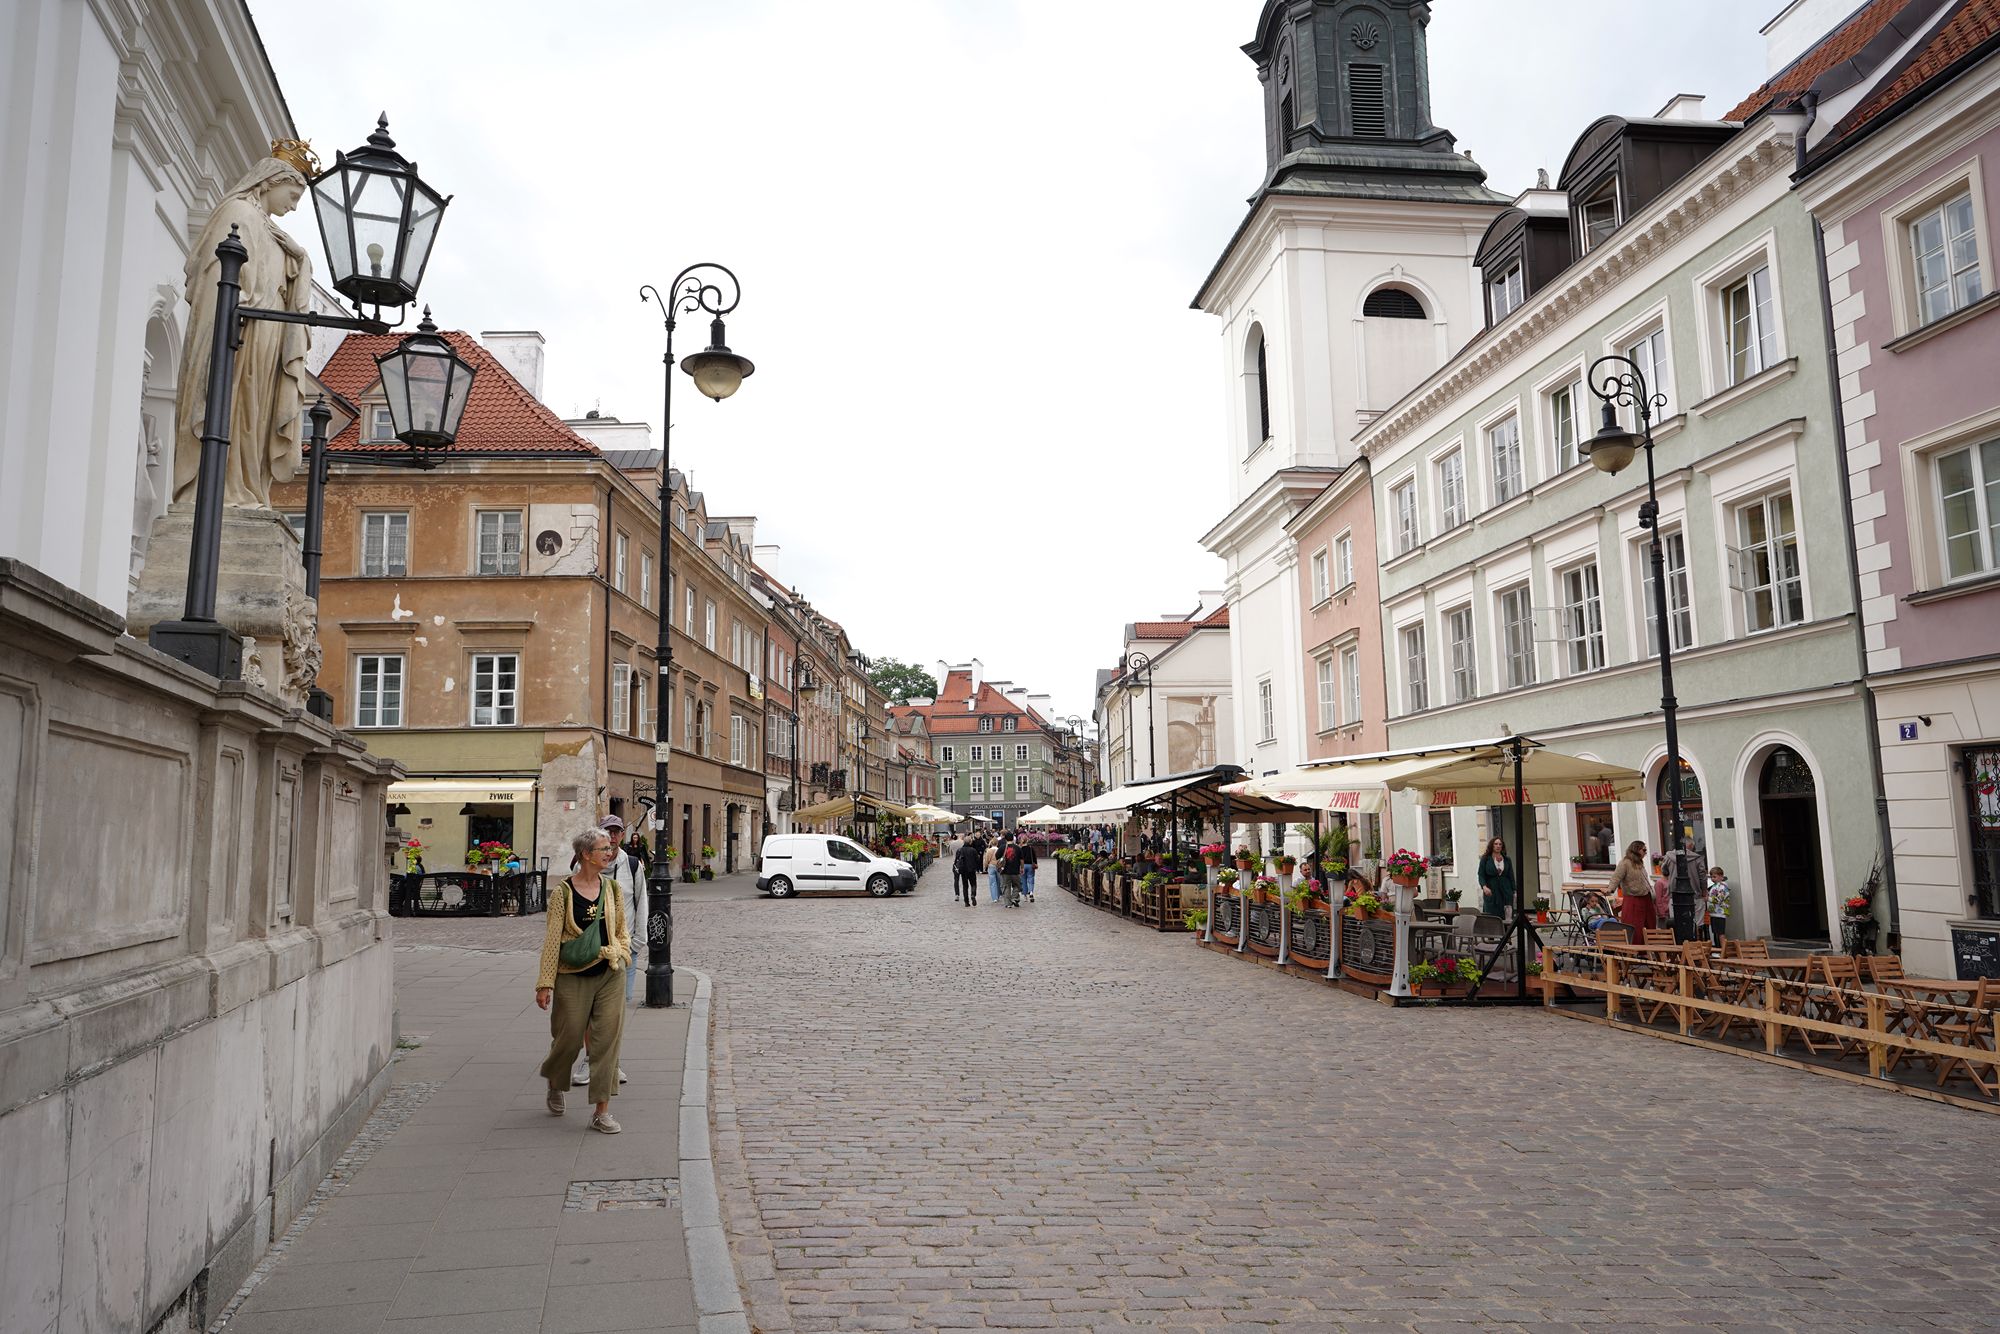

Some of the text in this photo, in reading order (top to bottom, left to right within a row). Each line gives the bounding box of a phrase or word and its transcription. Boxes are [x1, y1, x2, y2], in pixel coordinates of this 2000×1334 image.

[1905, 728, 1911, 738] 2
[489, 792, 514, 800] ŻYWIEC
[1328, 790, 1361, 809] ŻYWIEC
